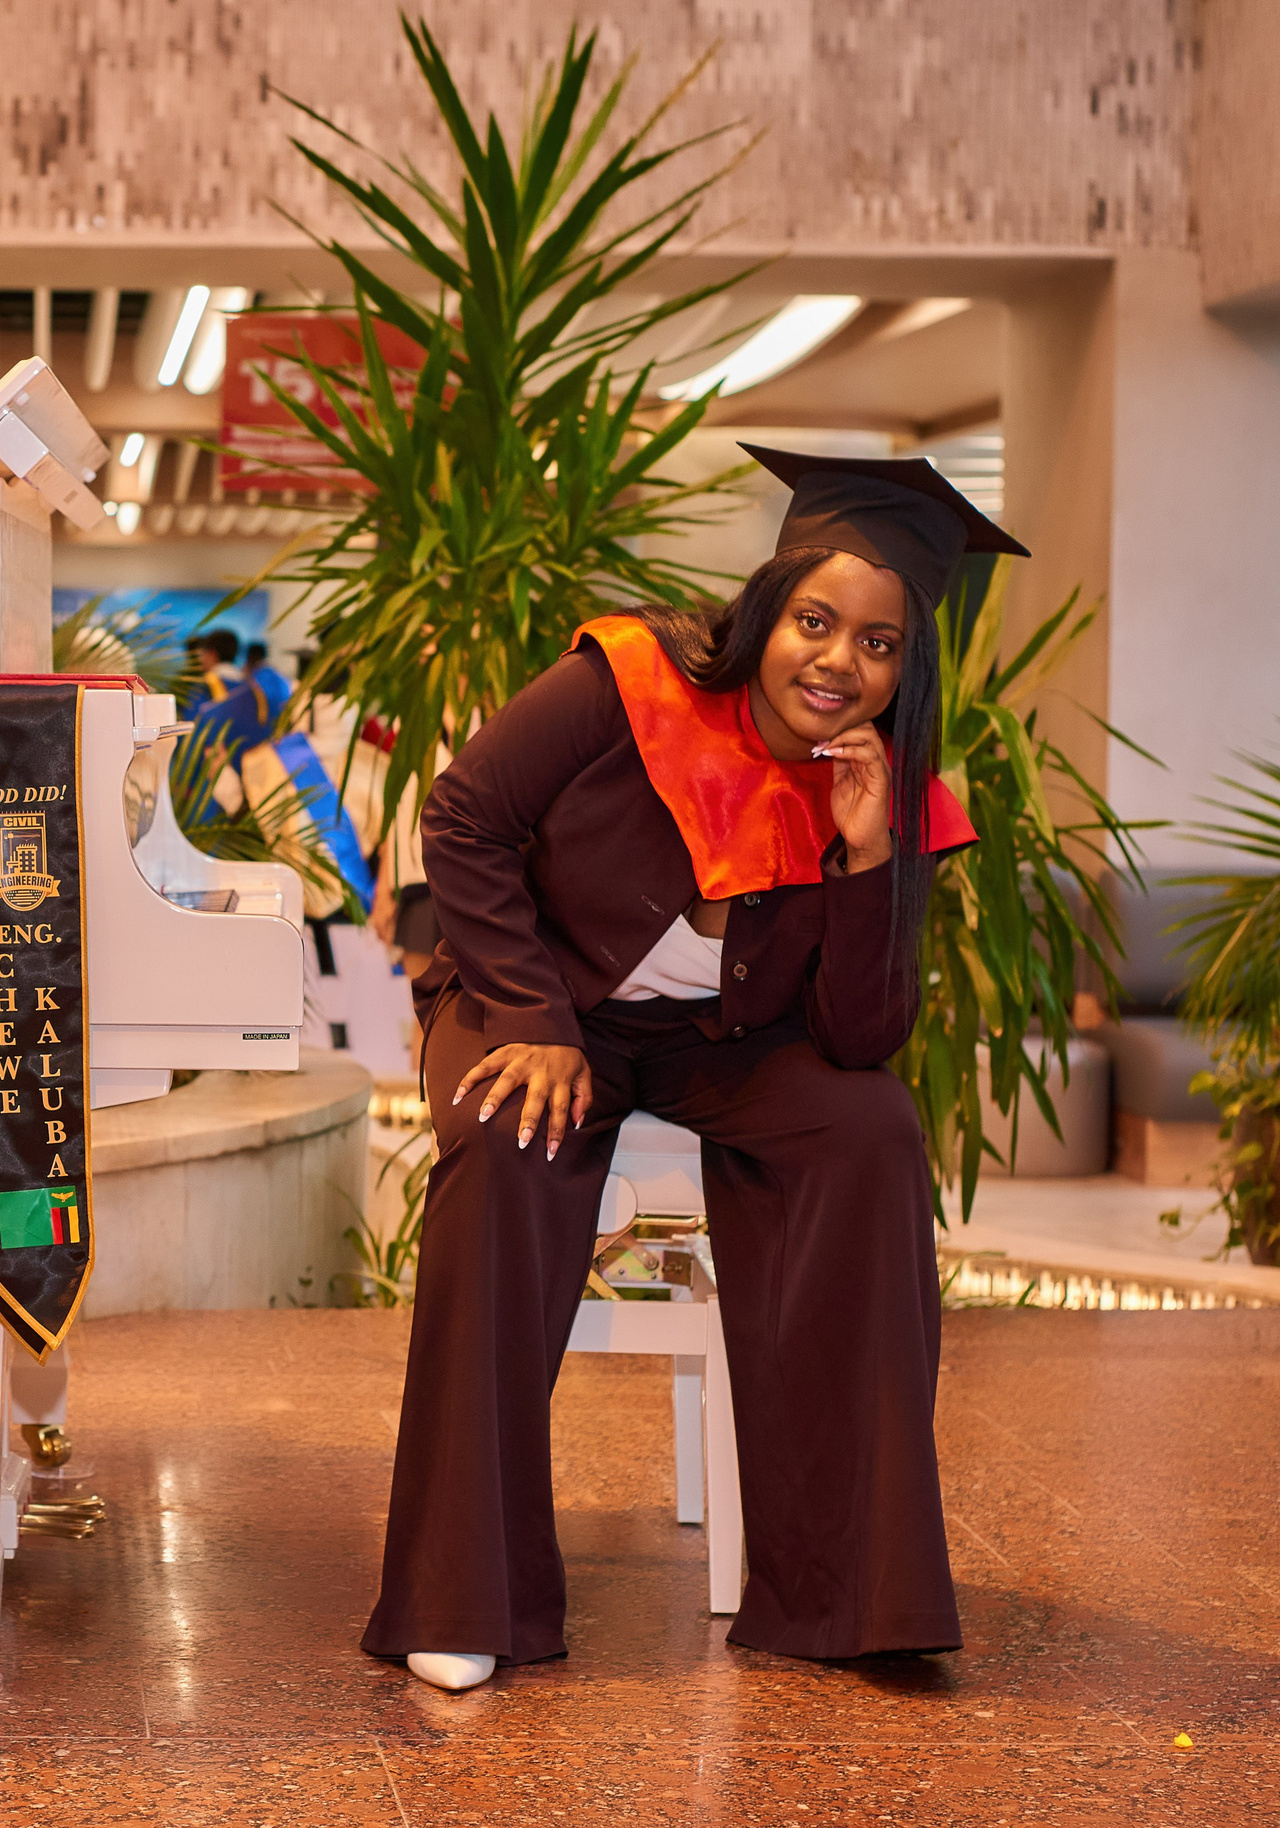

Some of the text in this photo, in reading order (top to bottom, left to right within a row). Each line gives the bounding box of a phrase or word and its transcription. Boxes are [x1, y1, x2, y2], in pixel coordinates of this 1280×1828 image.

[23, 784, 67, 803] DID!
[3, 816, 41, 827] CIVIL
[34, 986, 68, 1178] KALUBA
